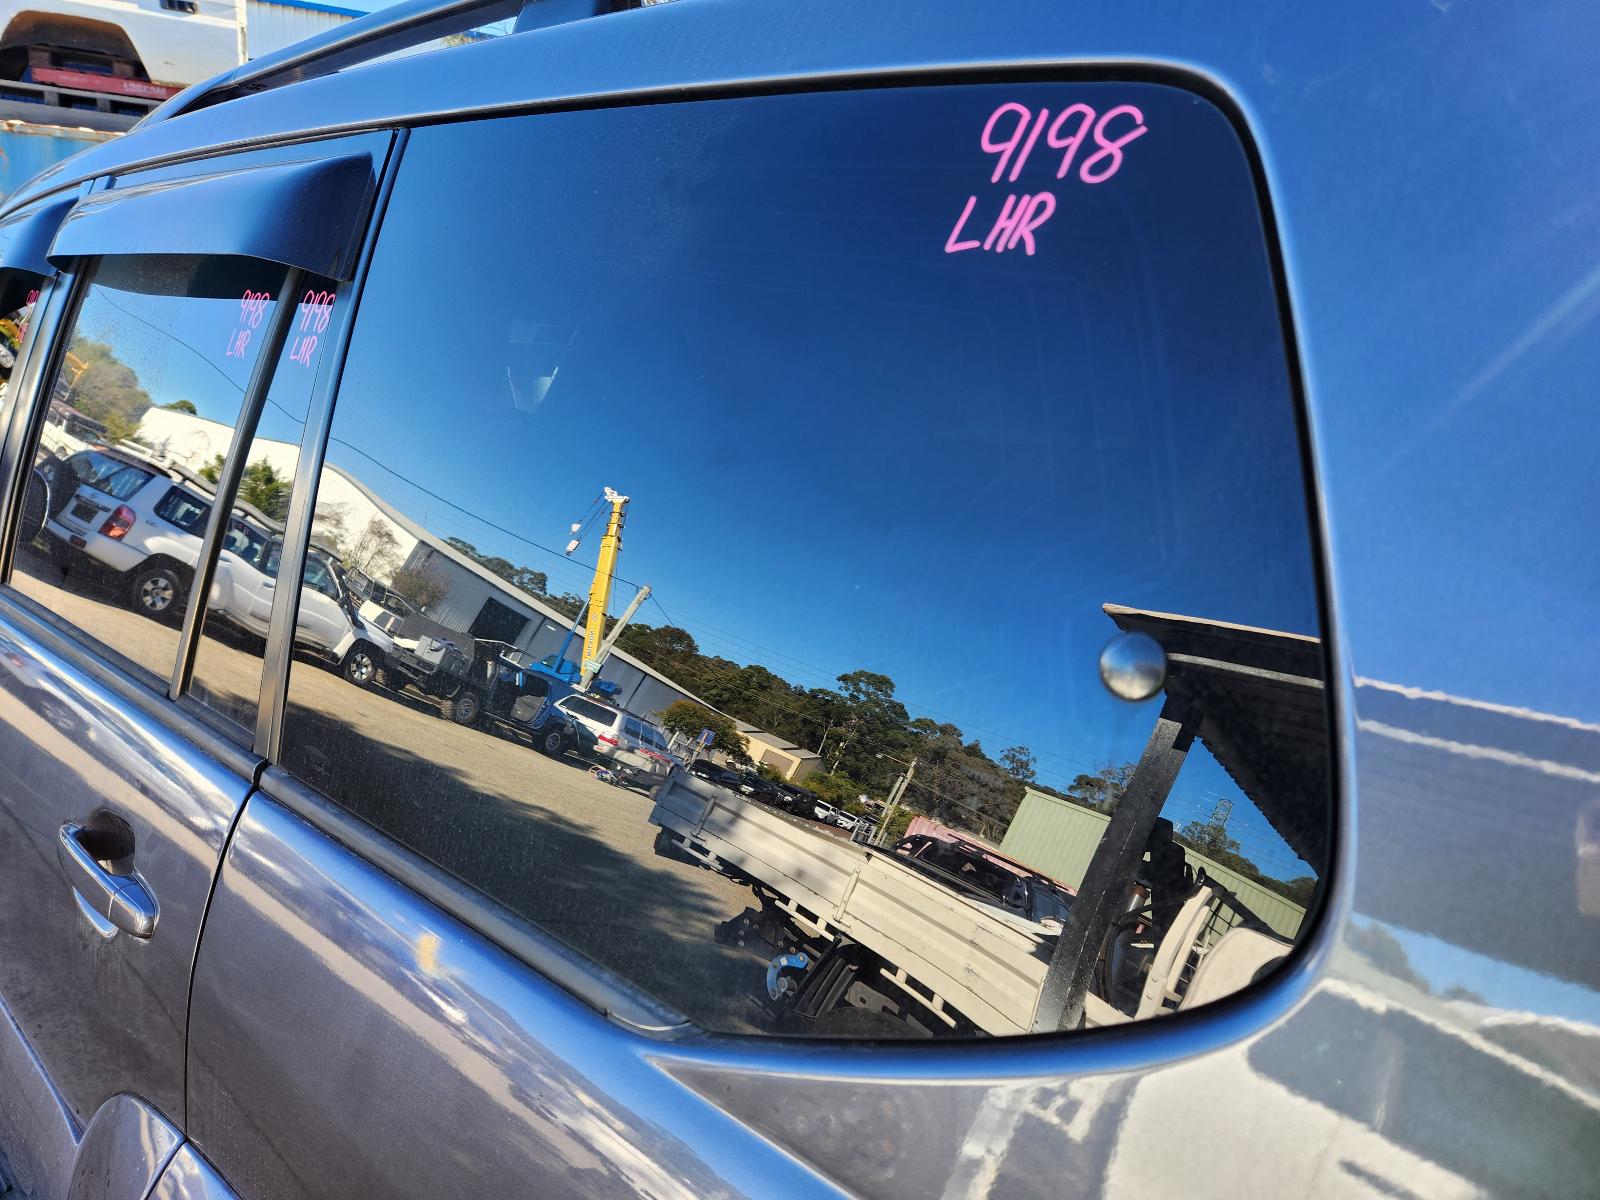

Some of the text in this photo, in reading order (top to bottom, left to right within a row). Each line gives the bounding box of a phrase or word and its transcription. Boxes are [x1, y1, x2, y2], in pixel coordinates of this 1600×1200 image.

[981, 102, 1148, 184] 9198
[944, 191, 1056, 256] LHR
[240, 289, 270, 329] 9198
[300, 289, 336, 334] 9198
[226, 327, 251, 359] LHR
[289, 335, 318, 368] LHR
